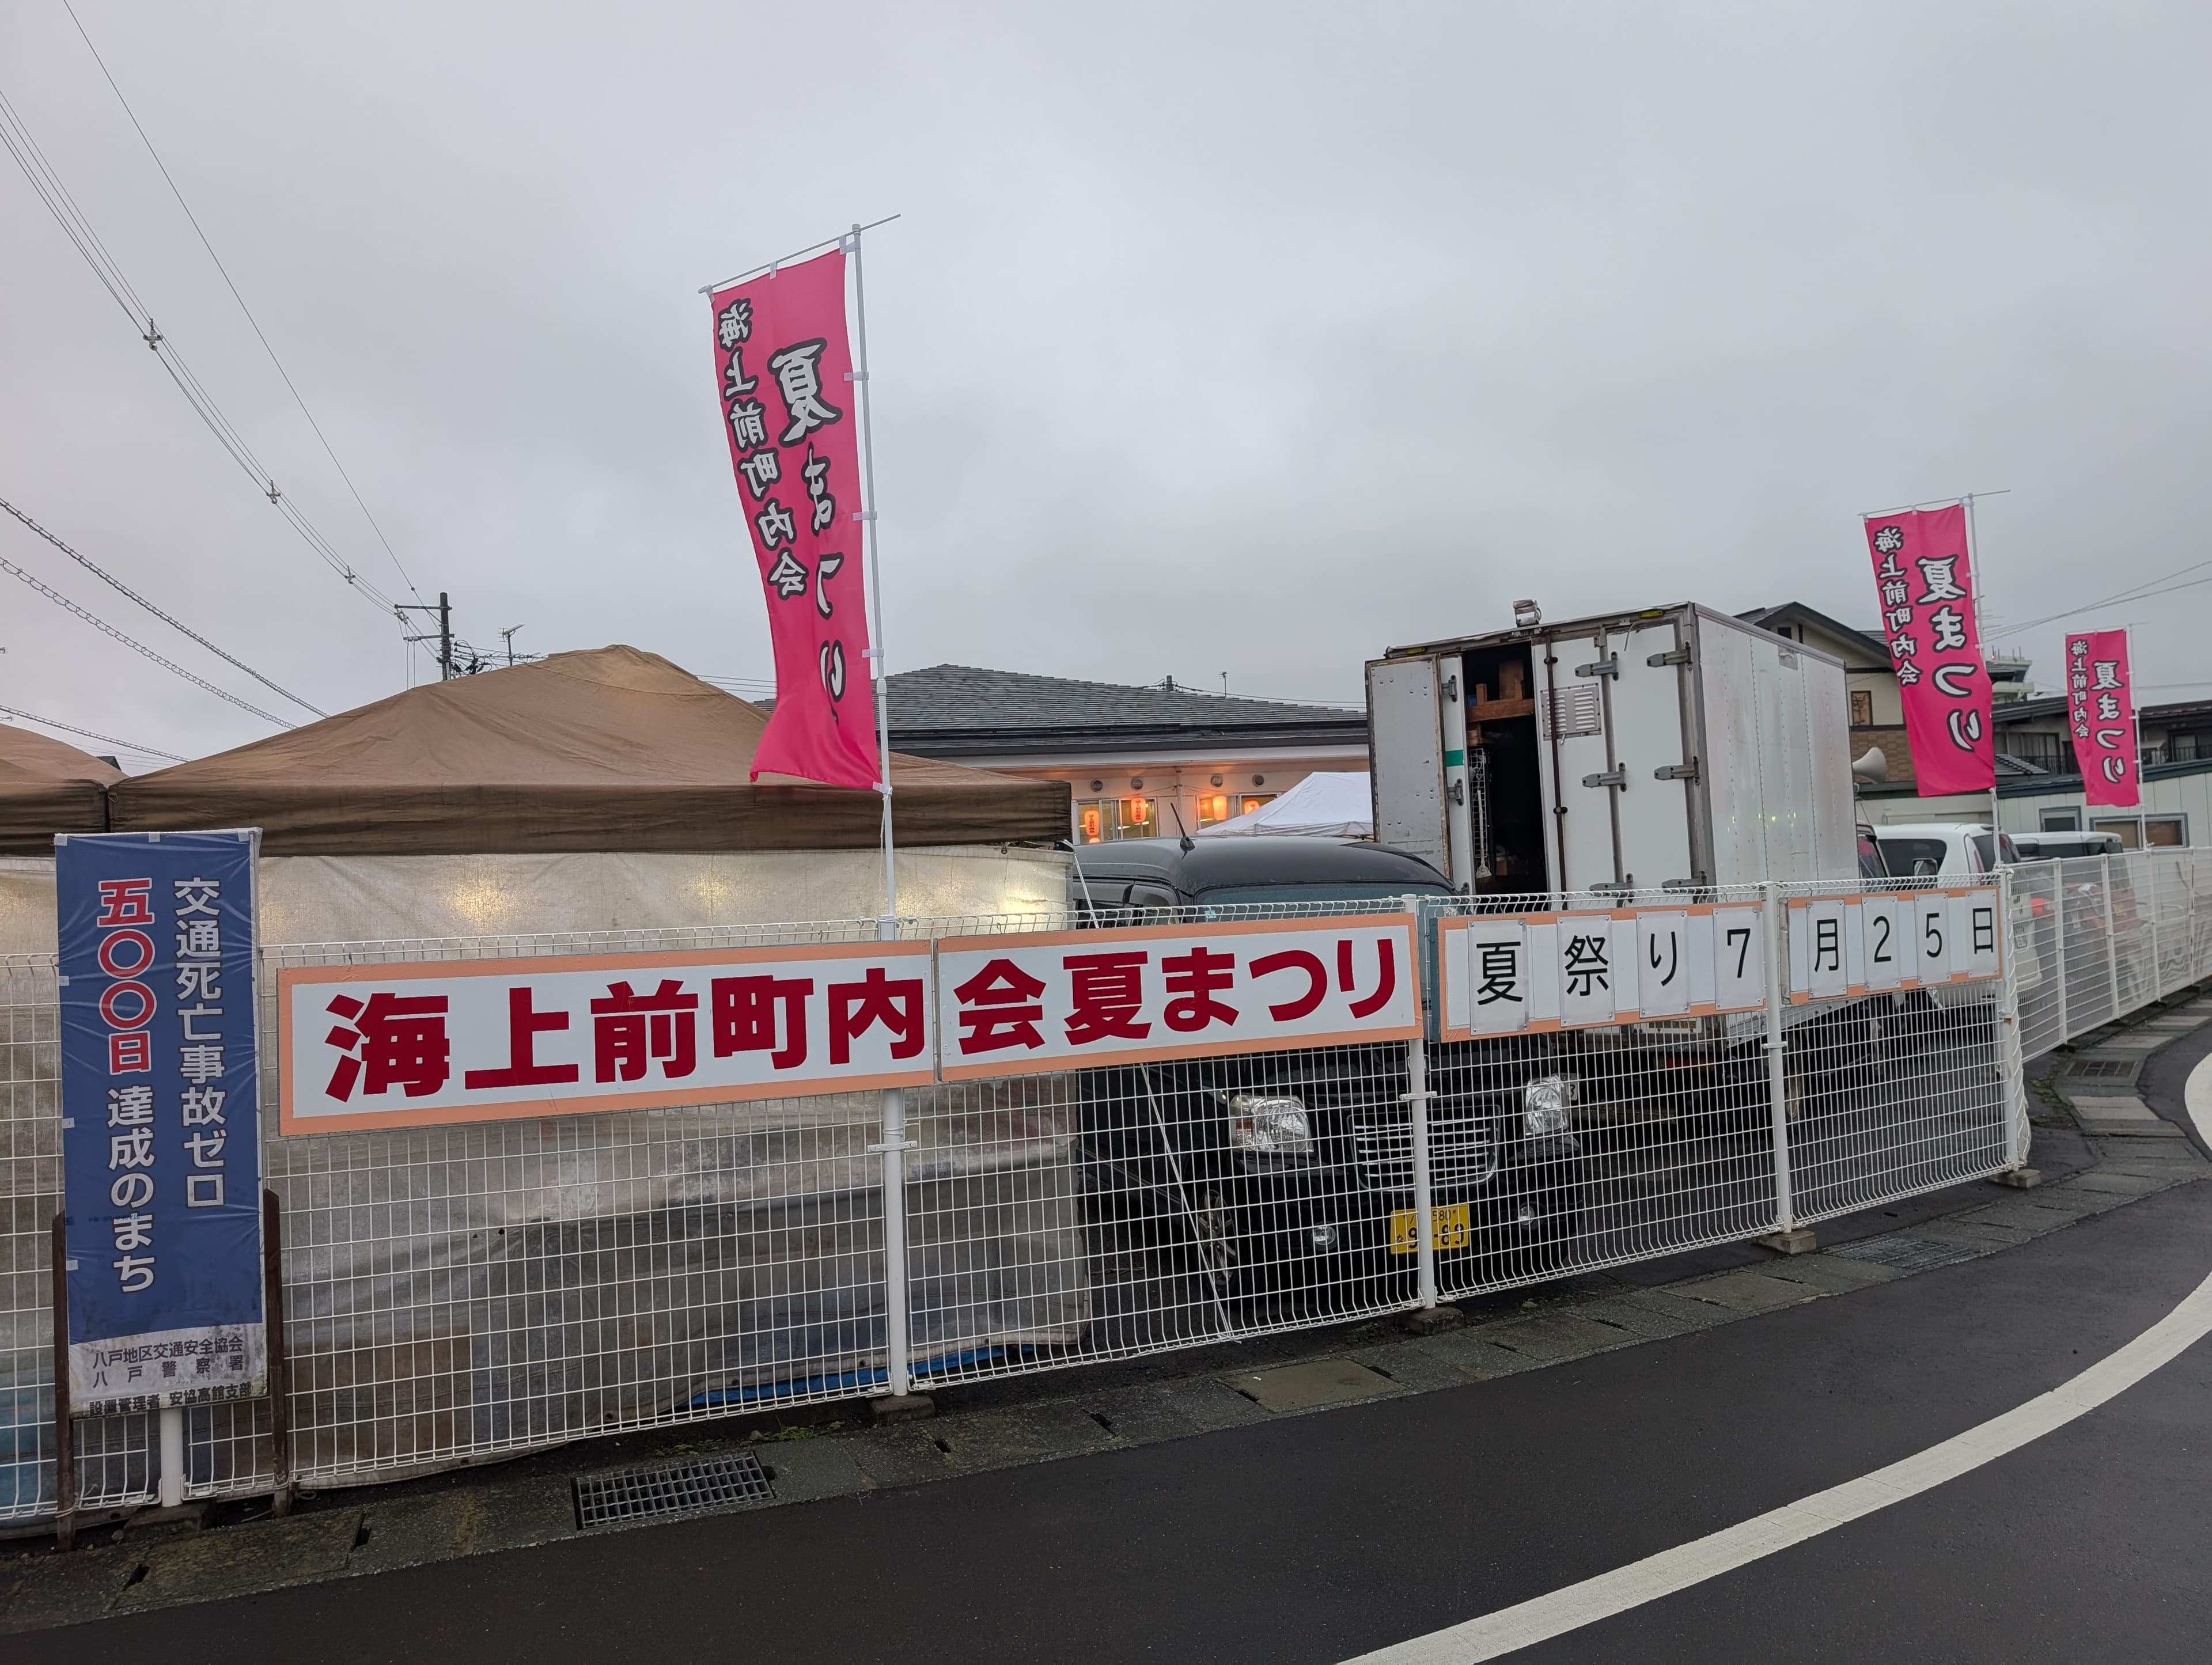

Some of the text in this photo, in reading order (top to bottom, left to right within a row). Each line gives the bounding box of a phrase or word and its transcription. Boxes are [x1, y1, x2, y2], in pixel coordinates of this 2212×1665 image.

[174, 877, 226, 1208] 交通死亡事故ゼロ
[92, 1336, 243, 1370] 八戸地区交通安全協会
[93, 1355, 244, 1389] 八戸警察署
[169, 1382, 252, 1406] 安協高館支部
